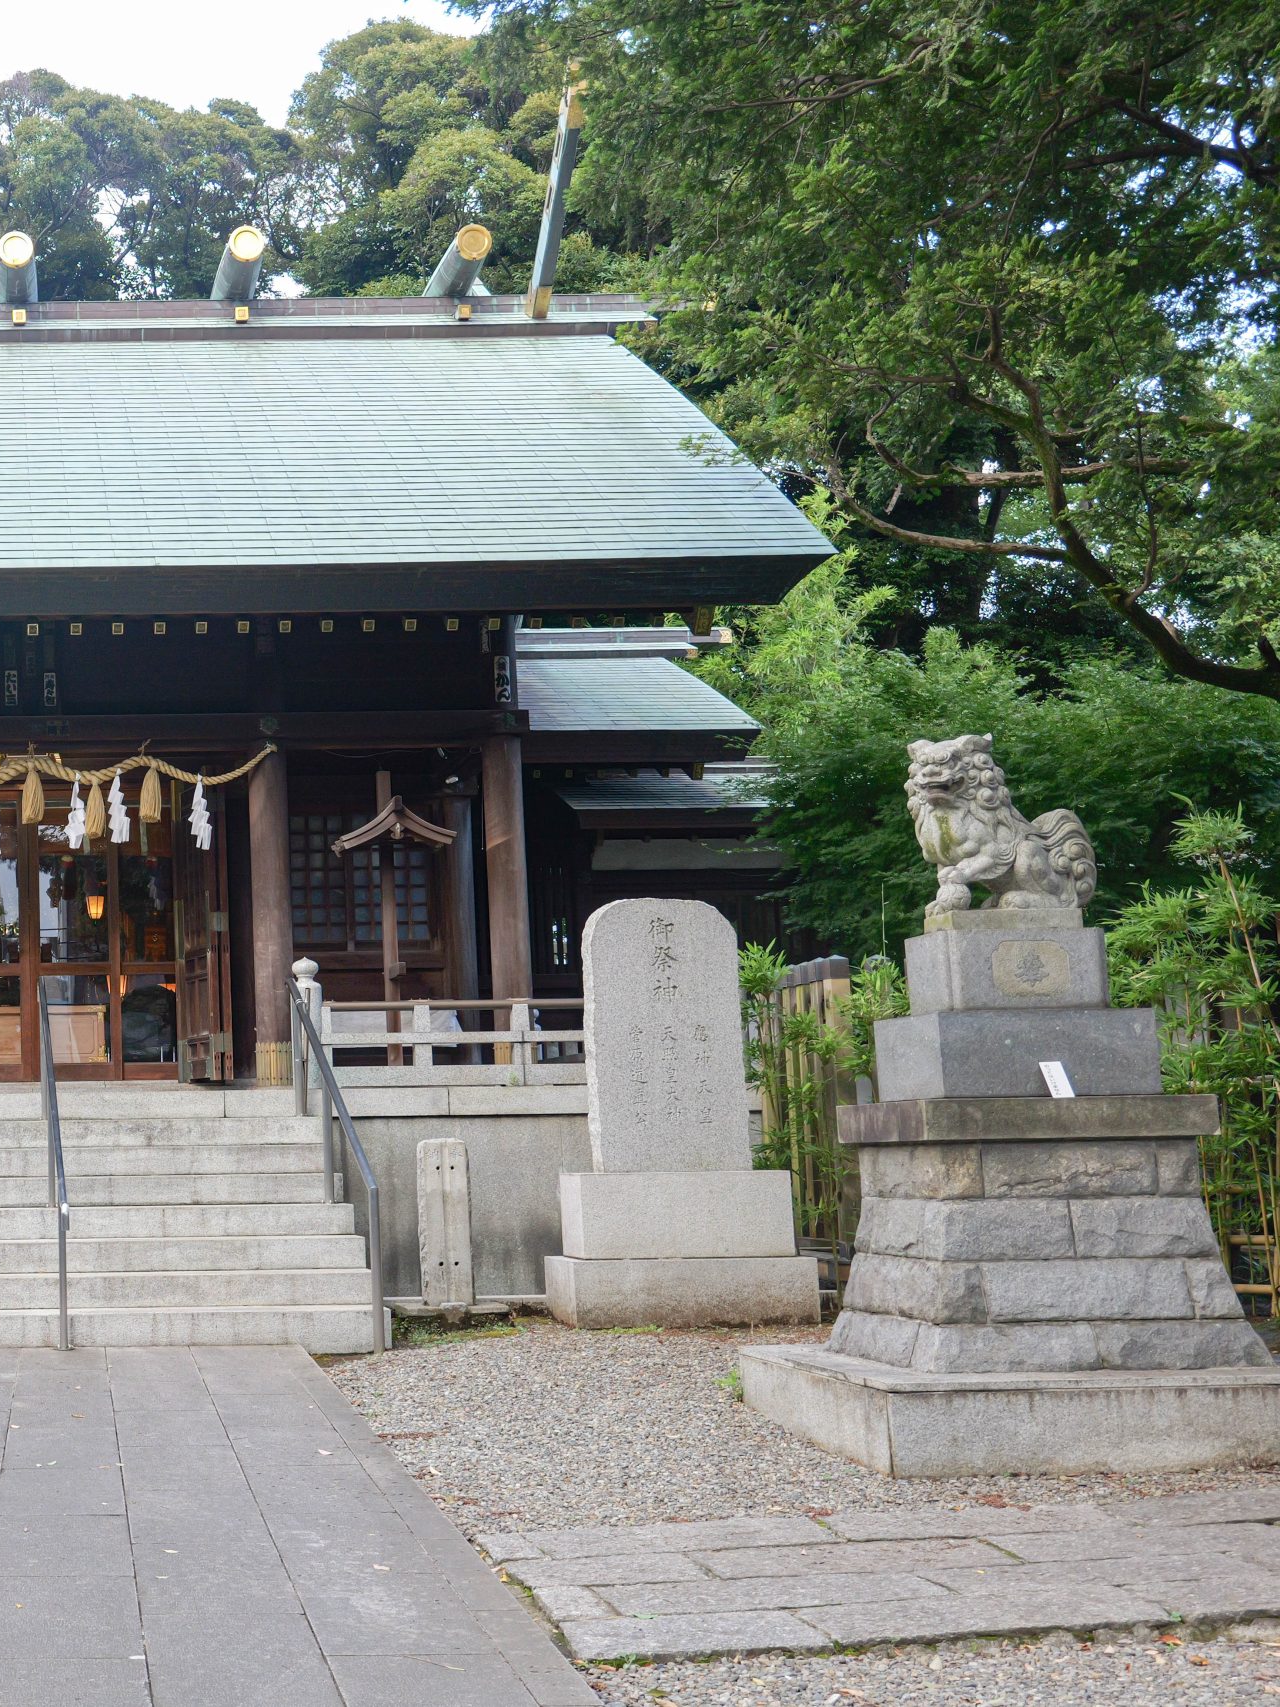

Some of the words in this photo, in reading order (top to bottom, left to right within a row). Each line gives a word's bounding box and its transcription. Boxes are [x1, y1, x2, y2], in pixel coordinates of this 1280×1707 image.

[647, 916, 679, 1004] 御祭神
[659, 1025, 682, 1124] 天照皇大神
